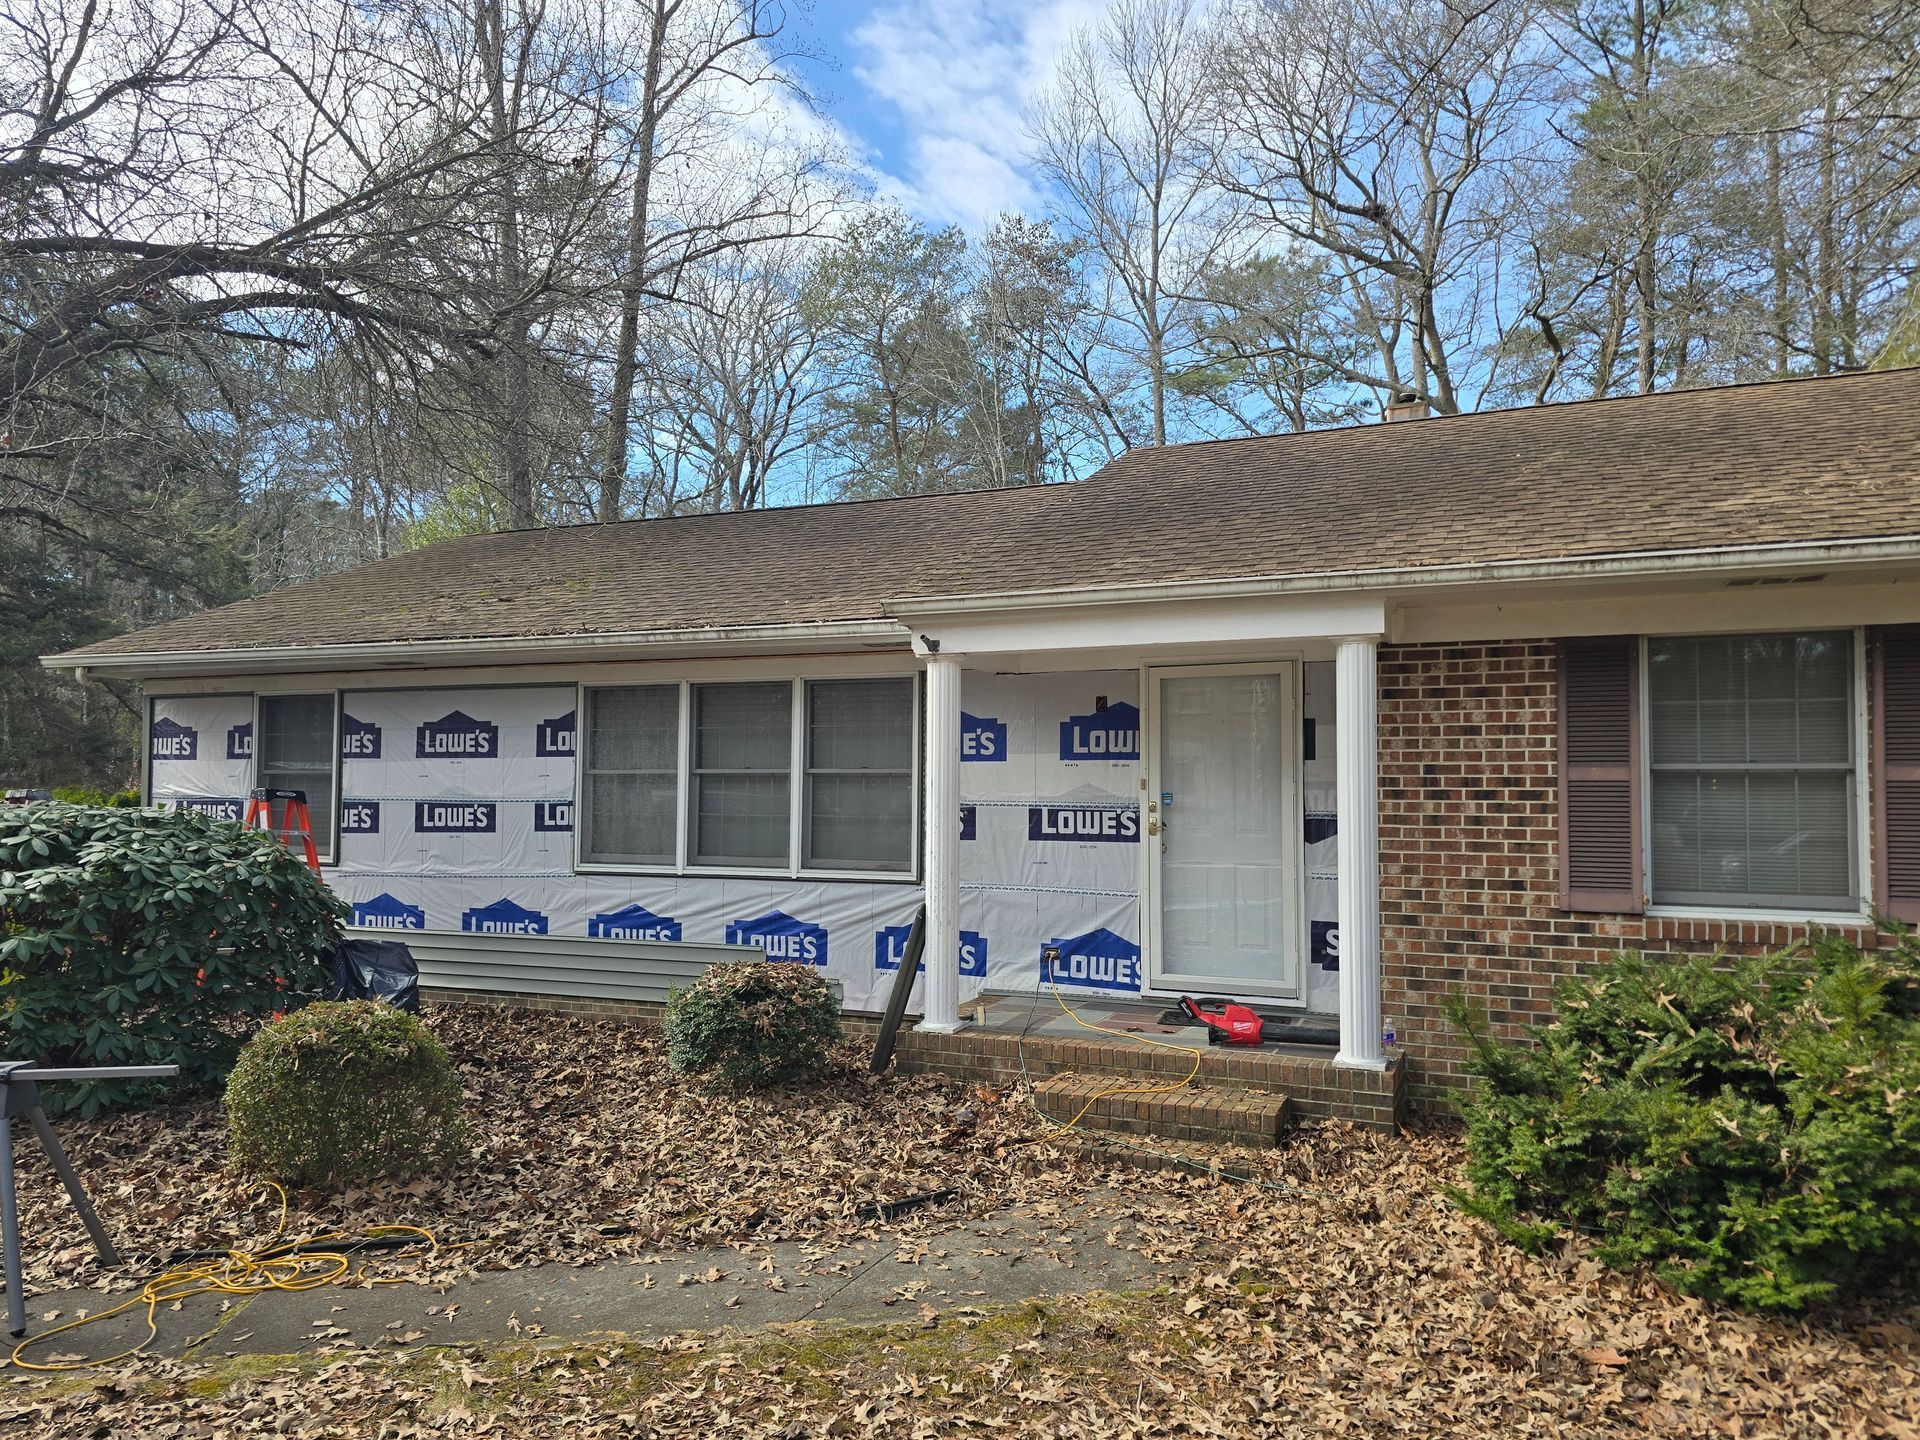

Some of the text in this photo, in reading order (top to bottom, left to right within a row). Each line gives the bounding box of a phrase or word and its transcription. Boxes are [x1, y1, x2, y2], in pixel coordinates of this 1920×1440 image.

[424, 730, 490, 753] LOWE'S
[1073, 726, 1139, 753] LOW
[423, 803, 488, 828] LOWE'S
[1041, 808, 1137, 836] LOWE'S
[736, 929, 817, 959] LOWE'S
